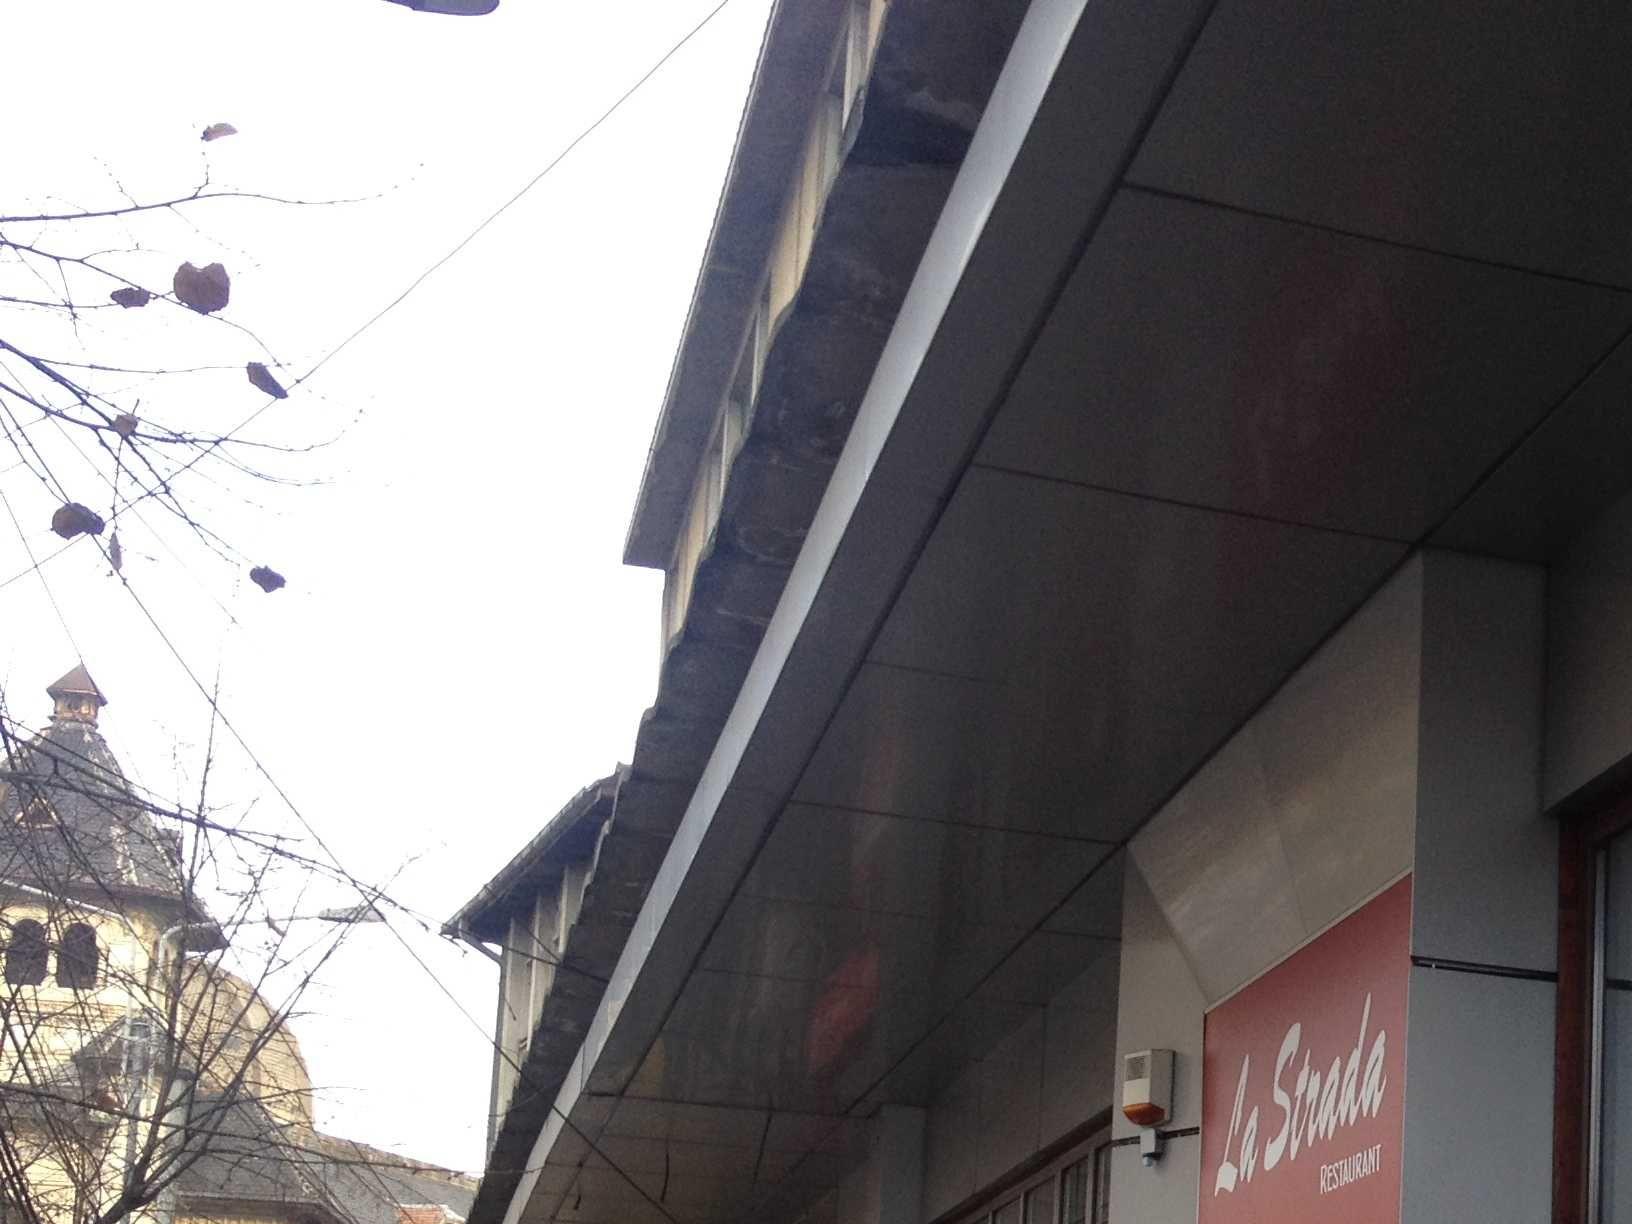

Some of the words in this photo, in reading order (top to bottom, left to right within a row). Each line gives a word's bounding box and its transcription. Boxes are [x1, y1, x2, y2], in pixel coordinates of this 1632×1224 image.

[1215, 1054, 1259, 1197] La
[1264, 992, 1387, 1171] Strada
[1320, 1144, 1382, 1195] RESTAURANT
